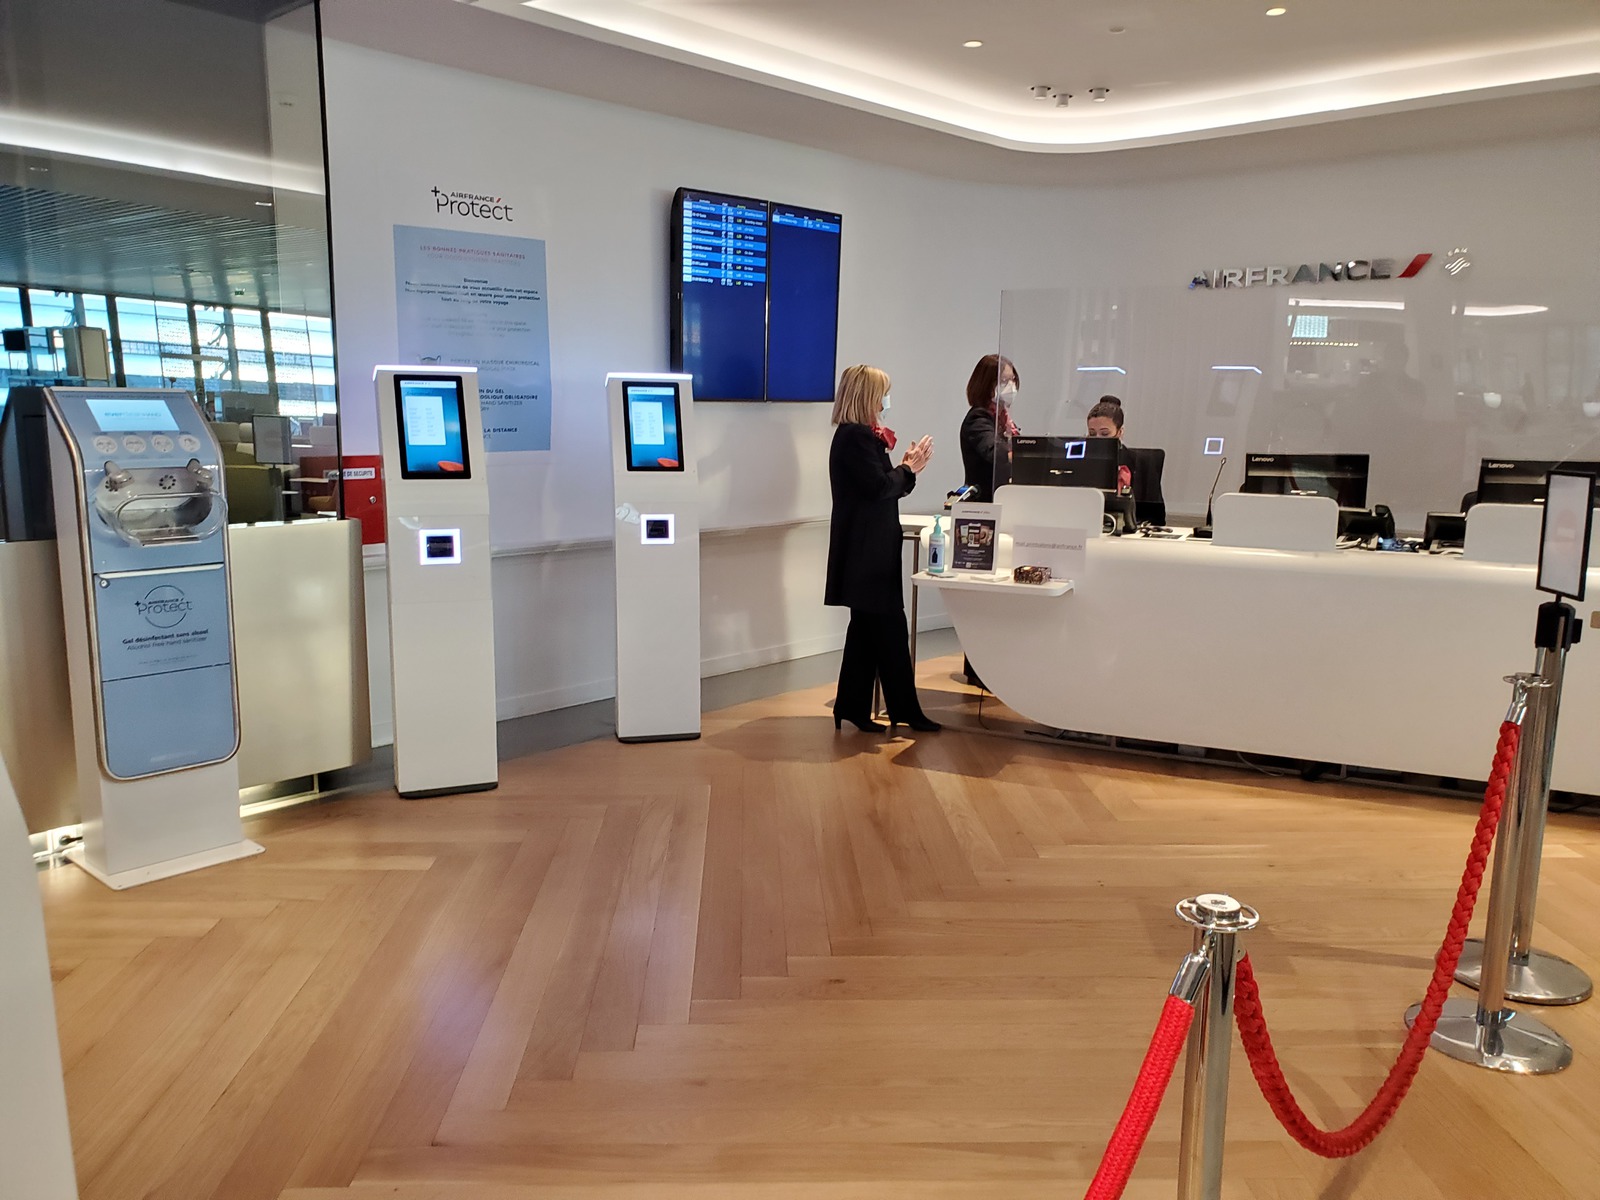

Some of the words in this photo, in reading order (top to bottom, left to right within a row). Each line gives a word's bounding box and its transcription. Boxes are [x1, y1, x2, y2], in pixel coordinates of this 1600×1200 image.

[450, 192, 494, 202] AIRFRANCE
[492, 251, 525, 260] SANITAIRES
[1188, 258, 1396, 288] AIRFRANCE
